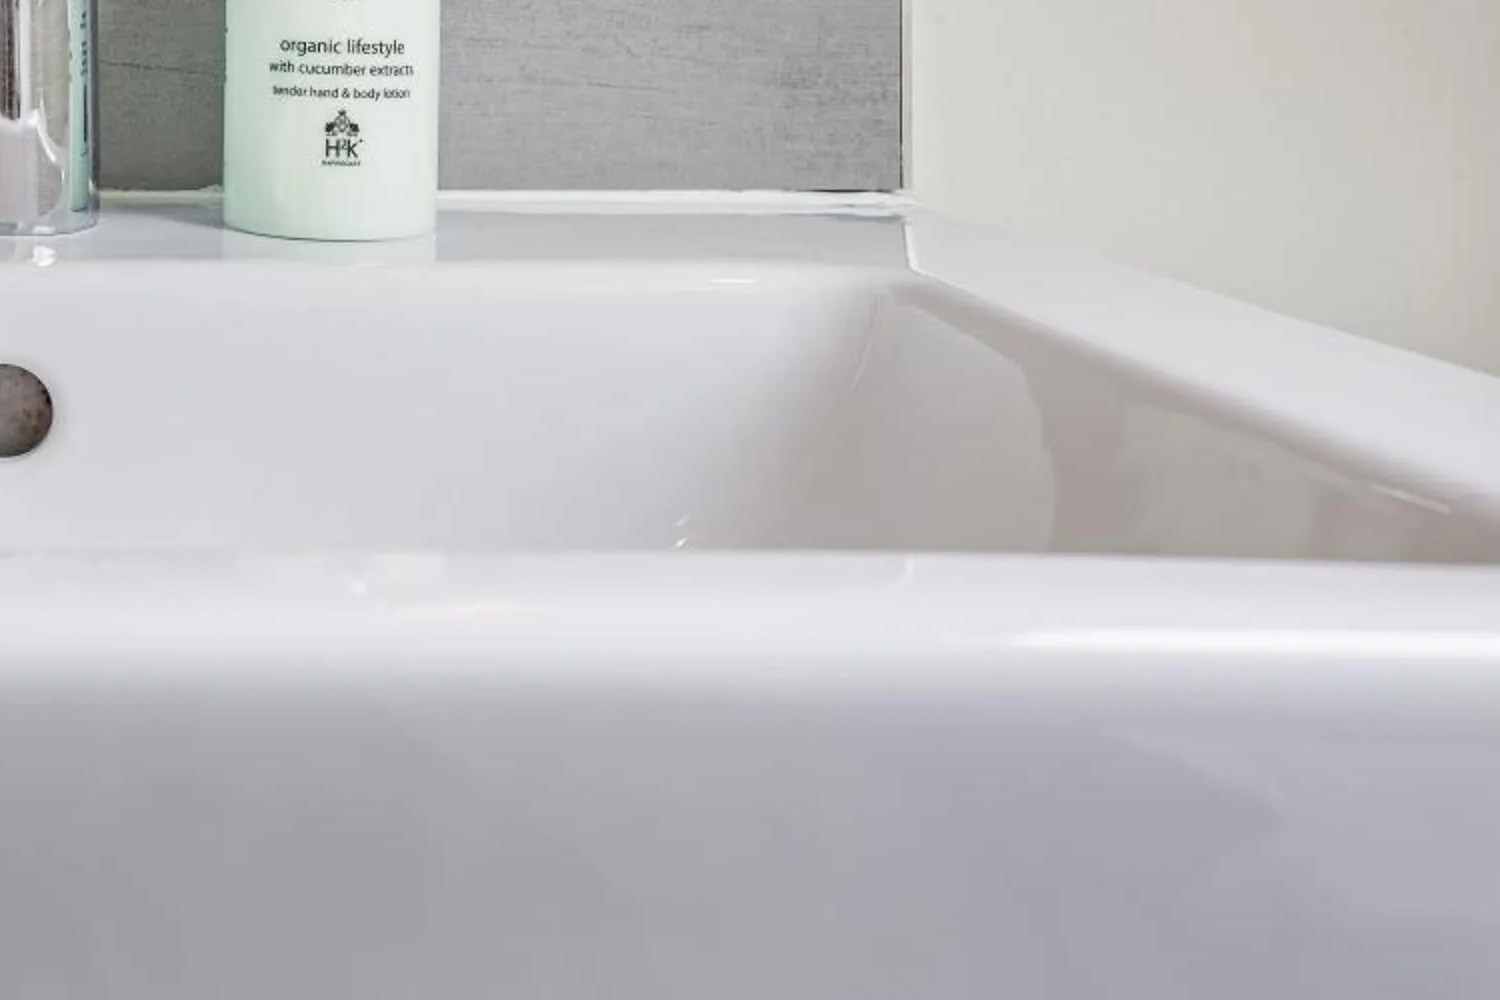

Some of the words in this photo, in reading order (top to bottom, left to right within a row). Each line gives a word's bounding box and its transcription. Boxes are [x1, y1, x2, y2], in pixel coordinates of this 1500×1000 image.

[279, 39, 342, 57] organic
[347, 38, 405, 58] lifestyle
[268, 60, 295, 73] with
[299, 62, 366, 76] cucumber
[369, 64, 415, 77] extracts
[272, 85, 307, 97] tender
[310, 86, 339, 99] hand
[341, 87, 351, 99] &
[353, 87, 381, 101] body
[383, 88, 411, 100] lotion
